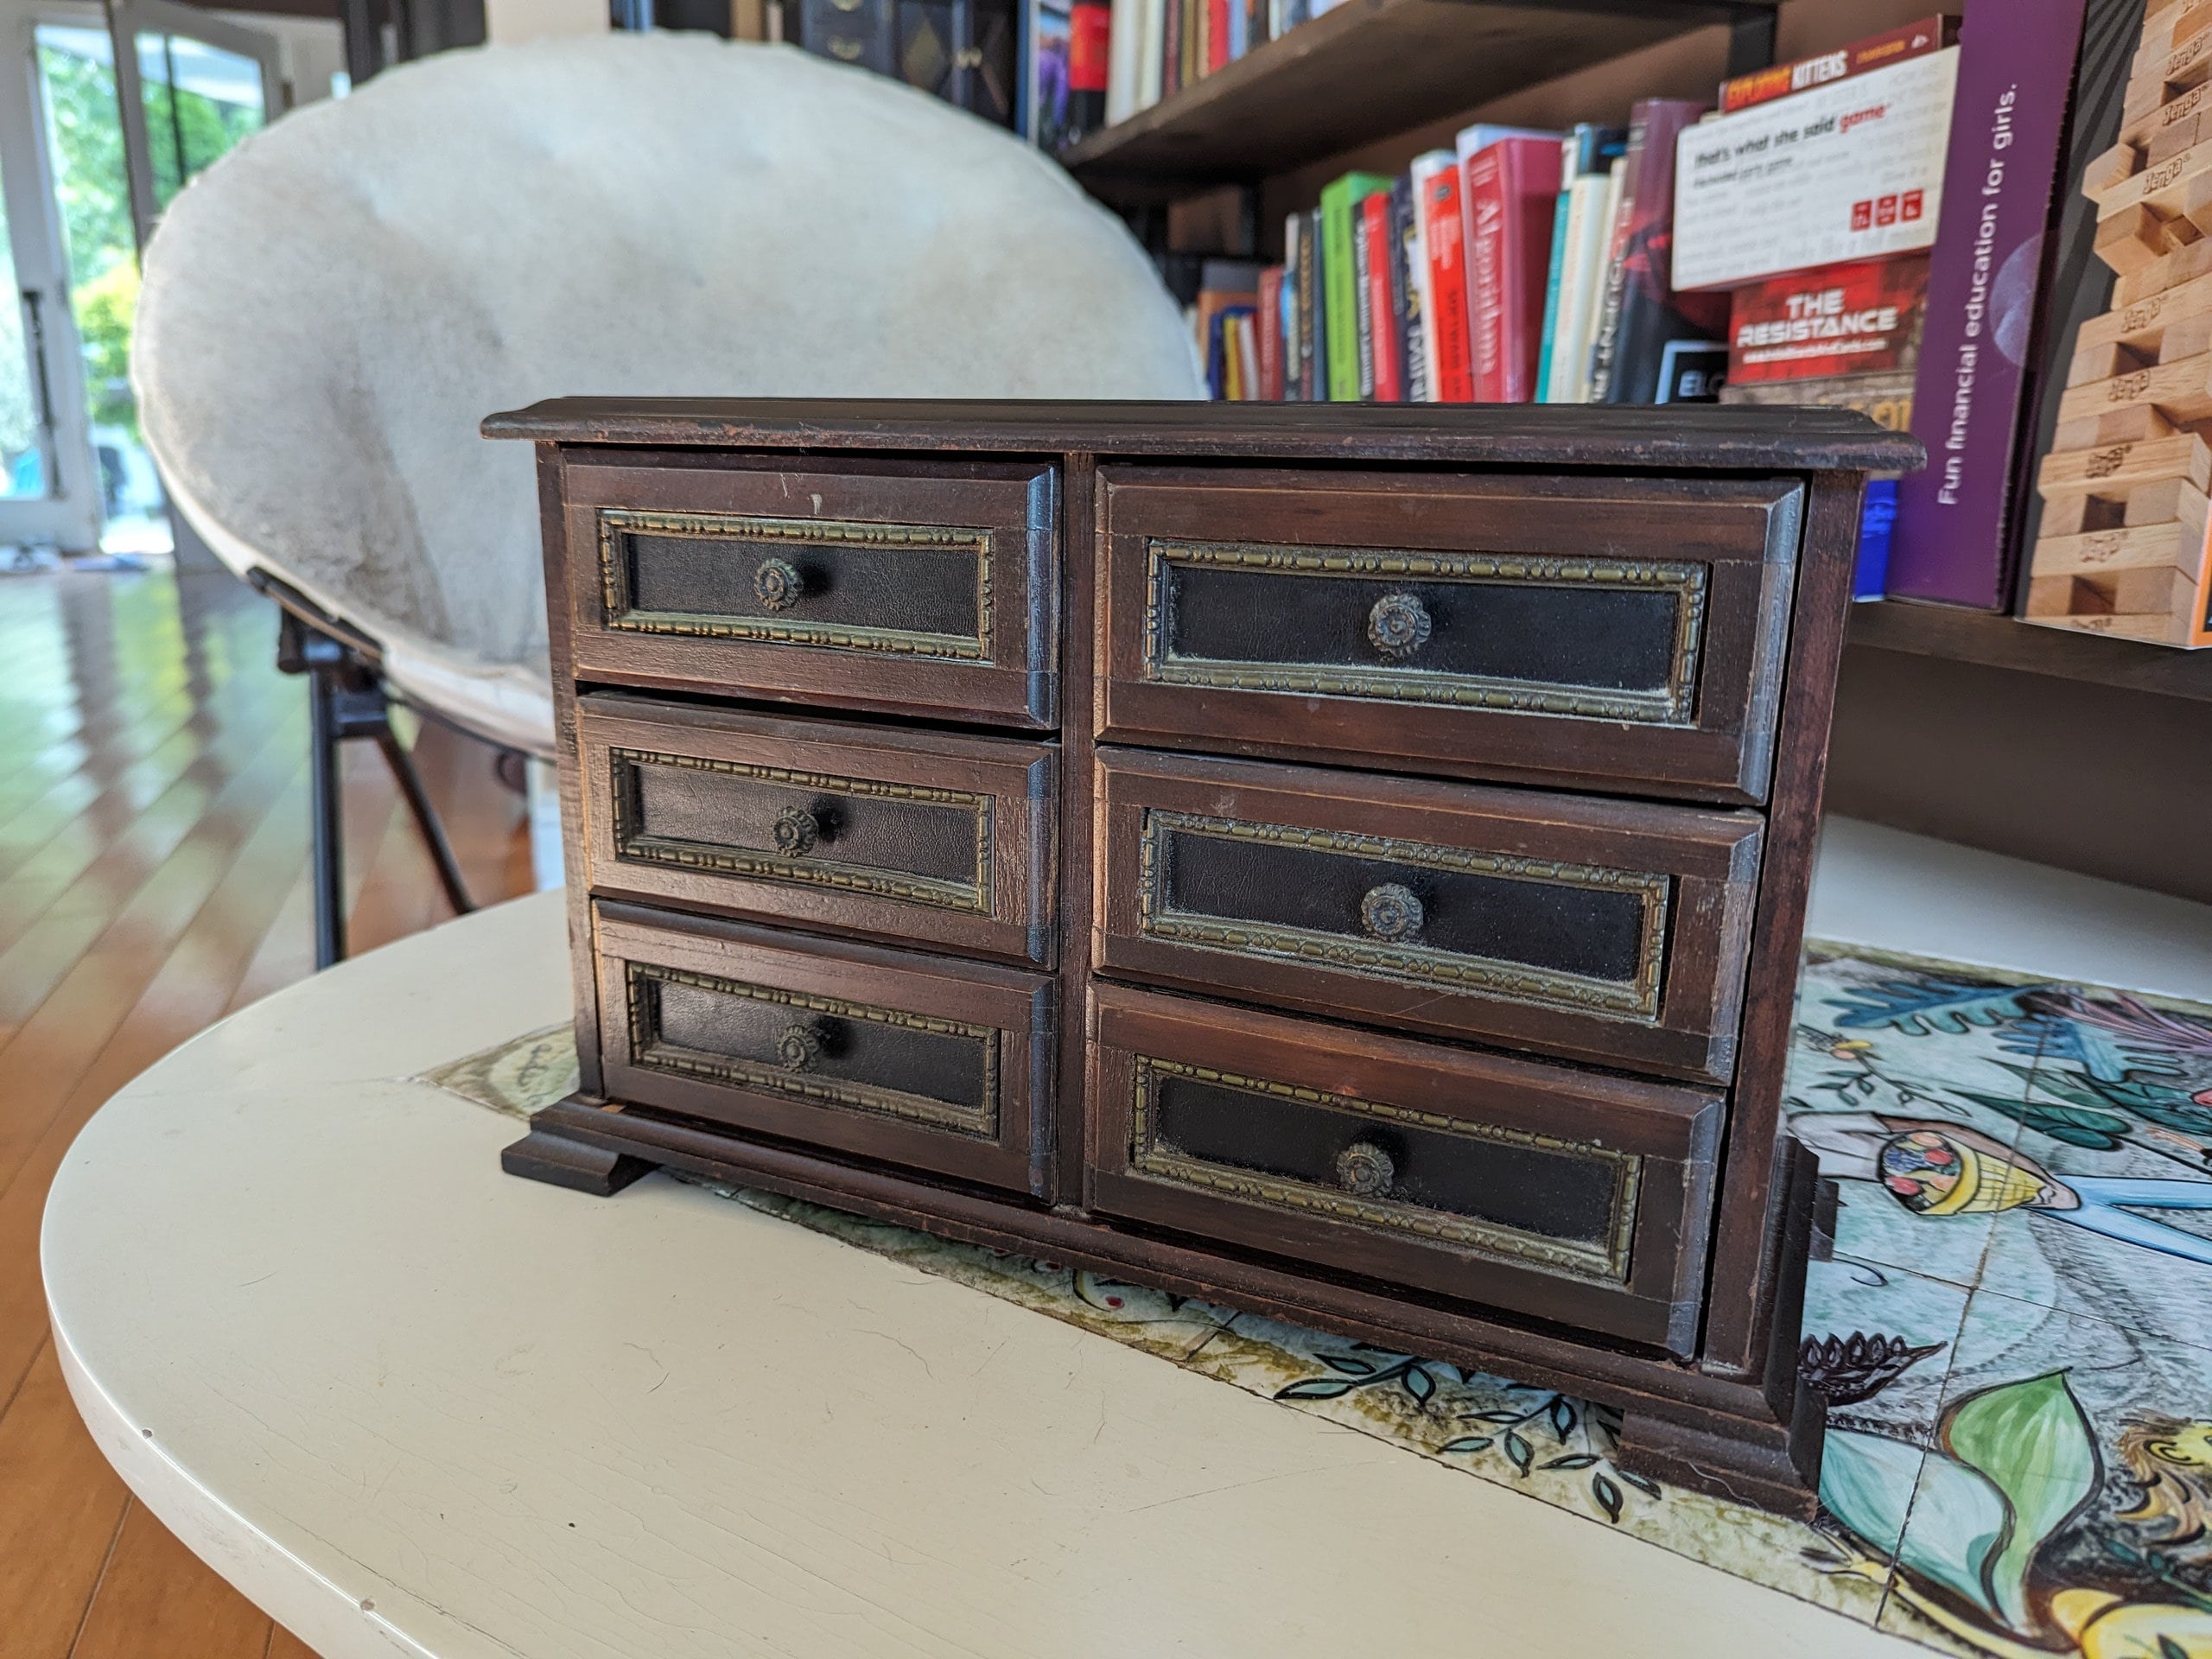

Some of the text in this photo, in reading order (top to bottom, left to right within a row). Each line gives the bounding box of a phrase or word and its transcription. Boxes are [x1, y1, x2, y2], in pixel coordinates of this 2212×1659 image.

[1791, 49, 1848, 91] KITTENS
[2166, 37, 2202, 75] Jenga
[2162, 88, 2202, 126] Jenga
[1694, 105, 1885, 168] that's what she said game
[2143, 158, 2182, 194] Jenga
[1474, 200, 1503, 376] Algorithms
[1785, 288, 1845, 320] THE
[1937, 82, 2018, 505] Fun financial education for girls.
[1736, 306, 1899, 348] RESISTANCE
